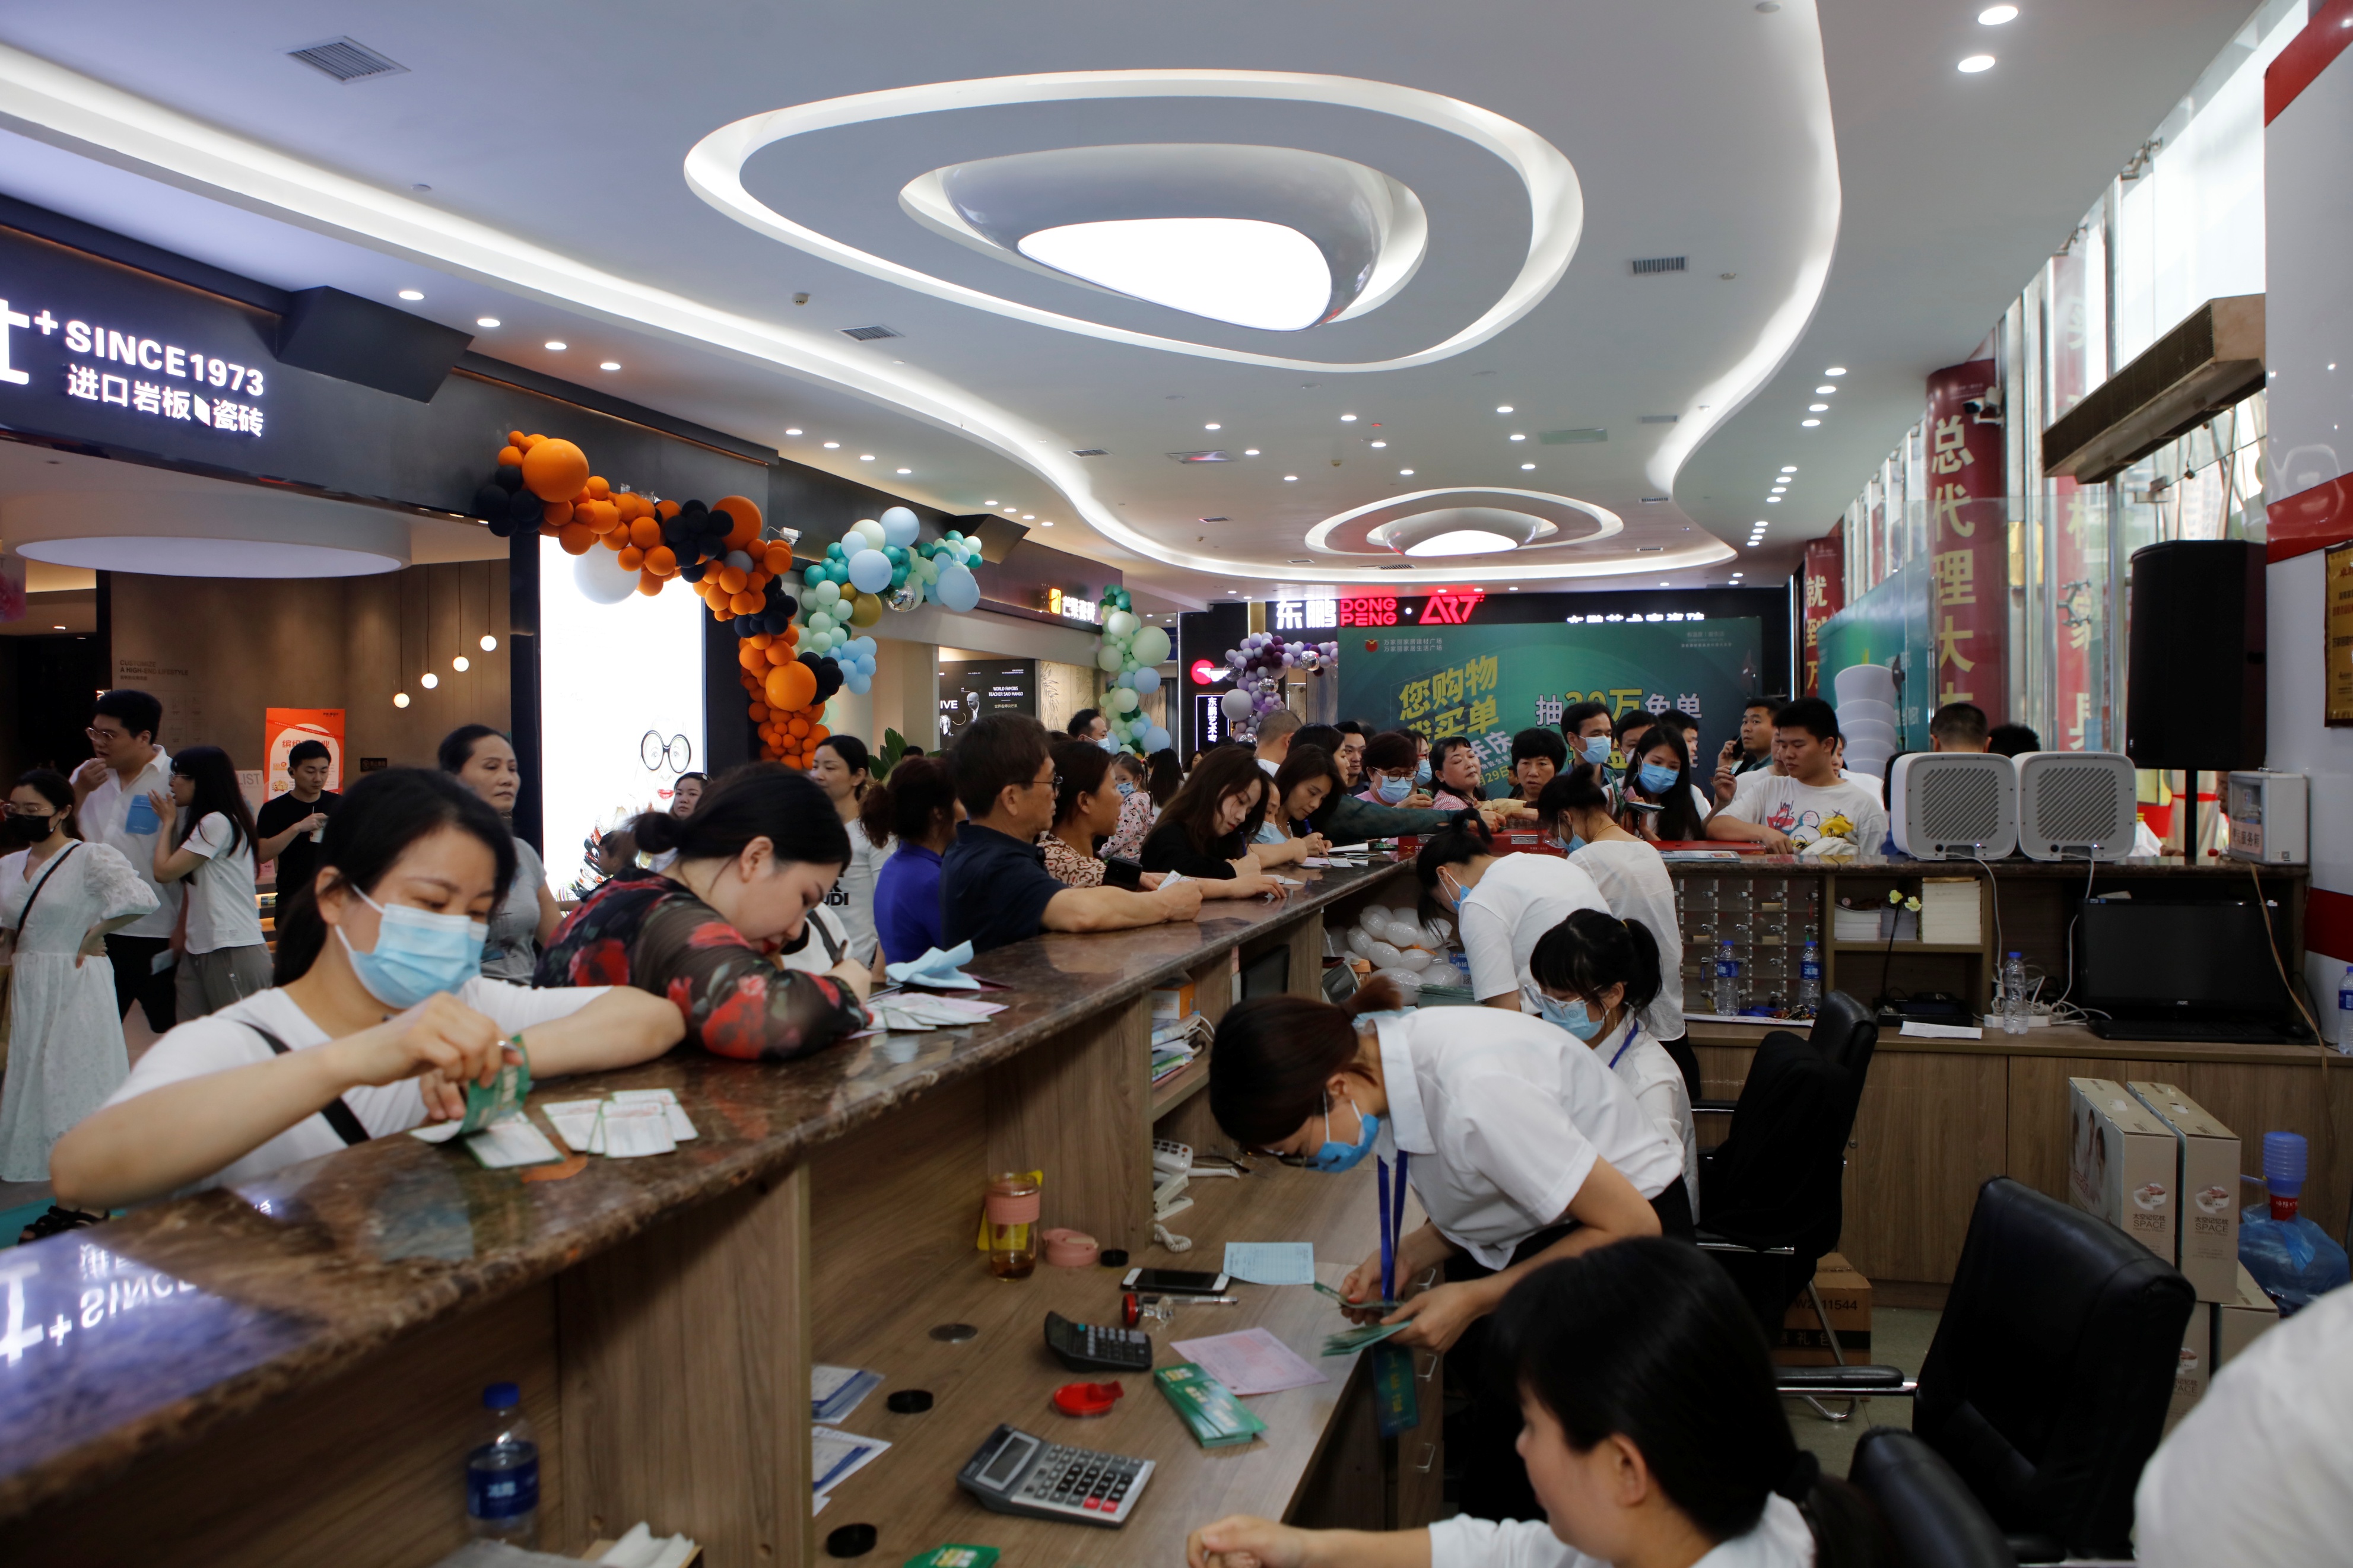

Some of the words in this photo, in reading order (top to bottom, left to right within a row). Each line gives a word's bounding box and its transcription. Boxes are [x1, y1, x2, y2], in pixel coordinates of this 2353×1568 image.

[65, 320, 264, 397] SINCE1973
[68, 363, 191, 421] 进口岩板
[212, 397, 265, 438] 瓷砖
[1339, 597, 1398, 612] DONG
[1418, 595, 1481, 624] ART
[1276, 598, 1337, 629] 东鹏
[1339, 612, 1398, 626] PENG
[1383, 638, 1443, 646] 万家丽家居建材广场
[1398, 655, 1498, 721] 您购物
[2133, 1213, 2166, 1222] 太空记忆枕
[2195, 1217, 2229, 1225] 太空记忆枕
[2133, 1220, 2166, 1230] SPACE
[2195, 1223, 2229, 1233] SPACE
